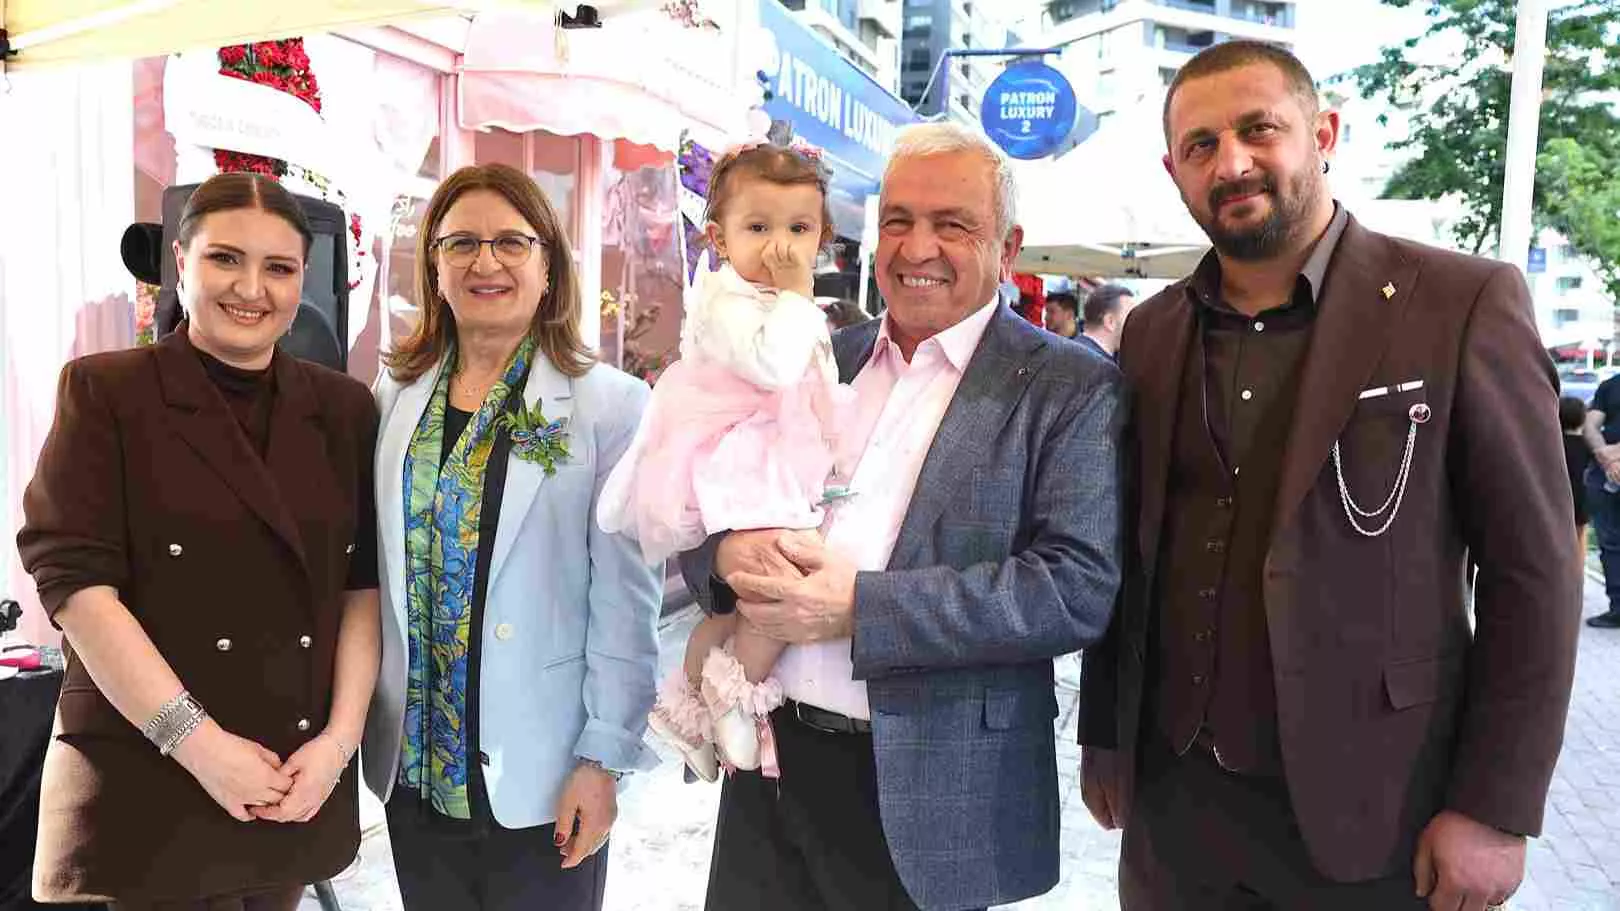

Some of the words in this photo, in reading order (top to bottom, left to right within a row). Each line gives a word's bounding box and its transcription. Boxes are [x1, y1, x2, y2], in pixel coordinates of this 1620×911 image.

[1000, 92, 1056, 105] PATRON
[1000, 106, 1055, 120] LUXURY
[1021, 120, 1032, 134] 2
